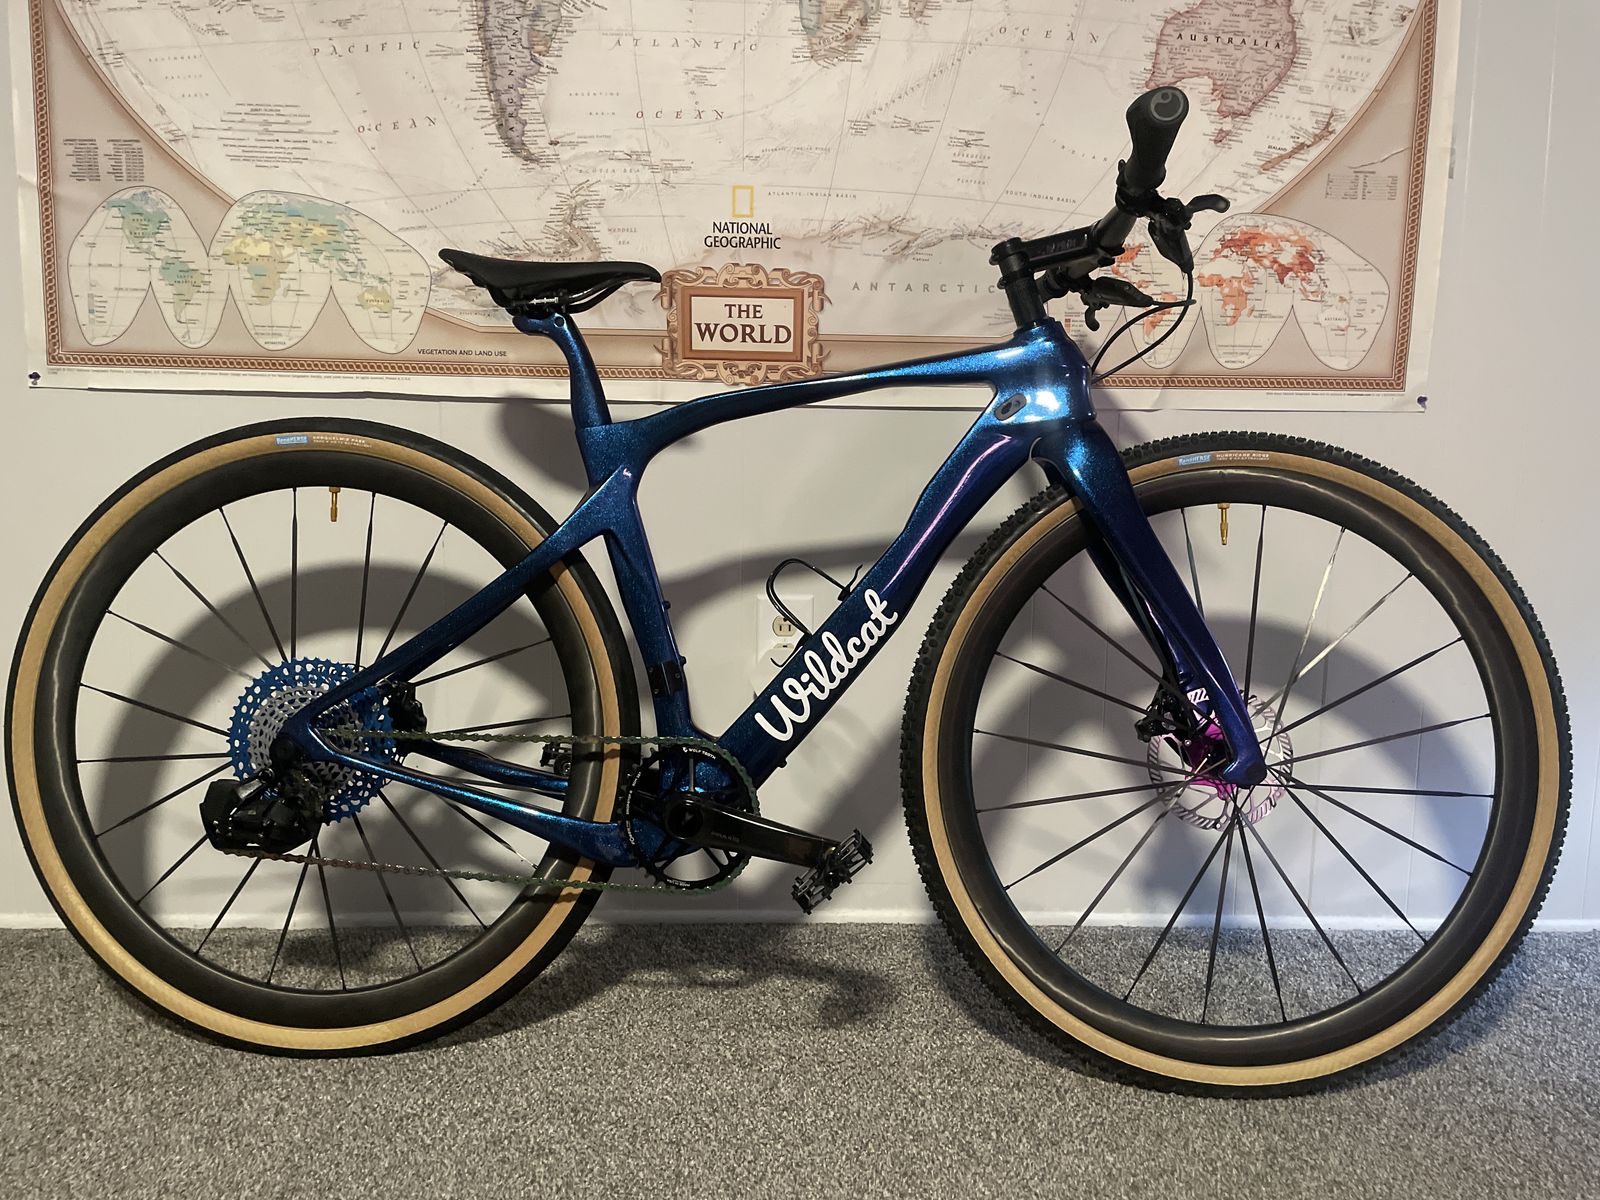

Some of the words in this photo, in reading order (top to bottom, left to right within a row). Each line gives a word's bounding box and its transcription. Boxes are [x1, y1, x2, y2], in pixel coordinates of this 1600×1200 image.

[1000, 27, 1100, 43] OCEAN
[1177, 33, 1282, 49] AUSTRALIA
[312, 41, 422, 57] PACIFIC
[613, 38, 758, 52] ATLANTIC
[508, 15, 522, 133] ARGENTINA
[636, 109, 724, 120] OCEAN
[357, 116, 438, 133] OCEAN
[1030, 193, 1054, 201] INDIAN
[712, 221, 773, 235] NATIONAL
[704, 235, 781, 249] GEOGRAPHIC
[724, 303, 764, 319] THE
[695, 322, 792, 344] WORLD
[754, 588, 898, 742] Wildcat
